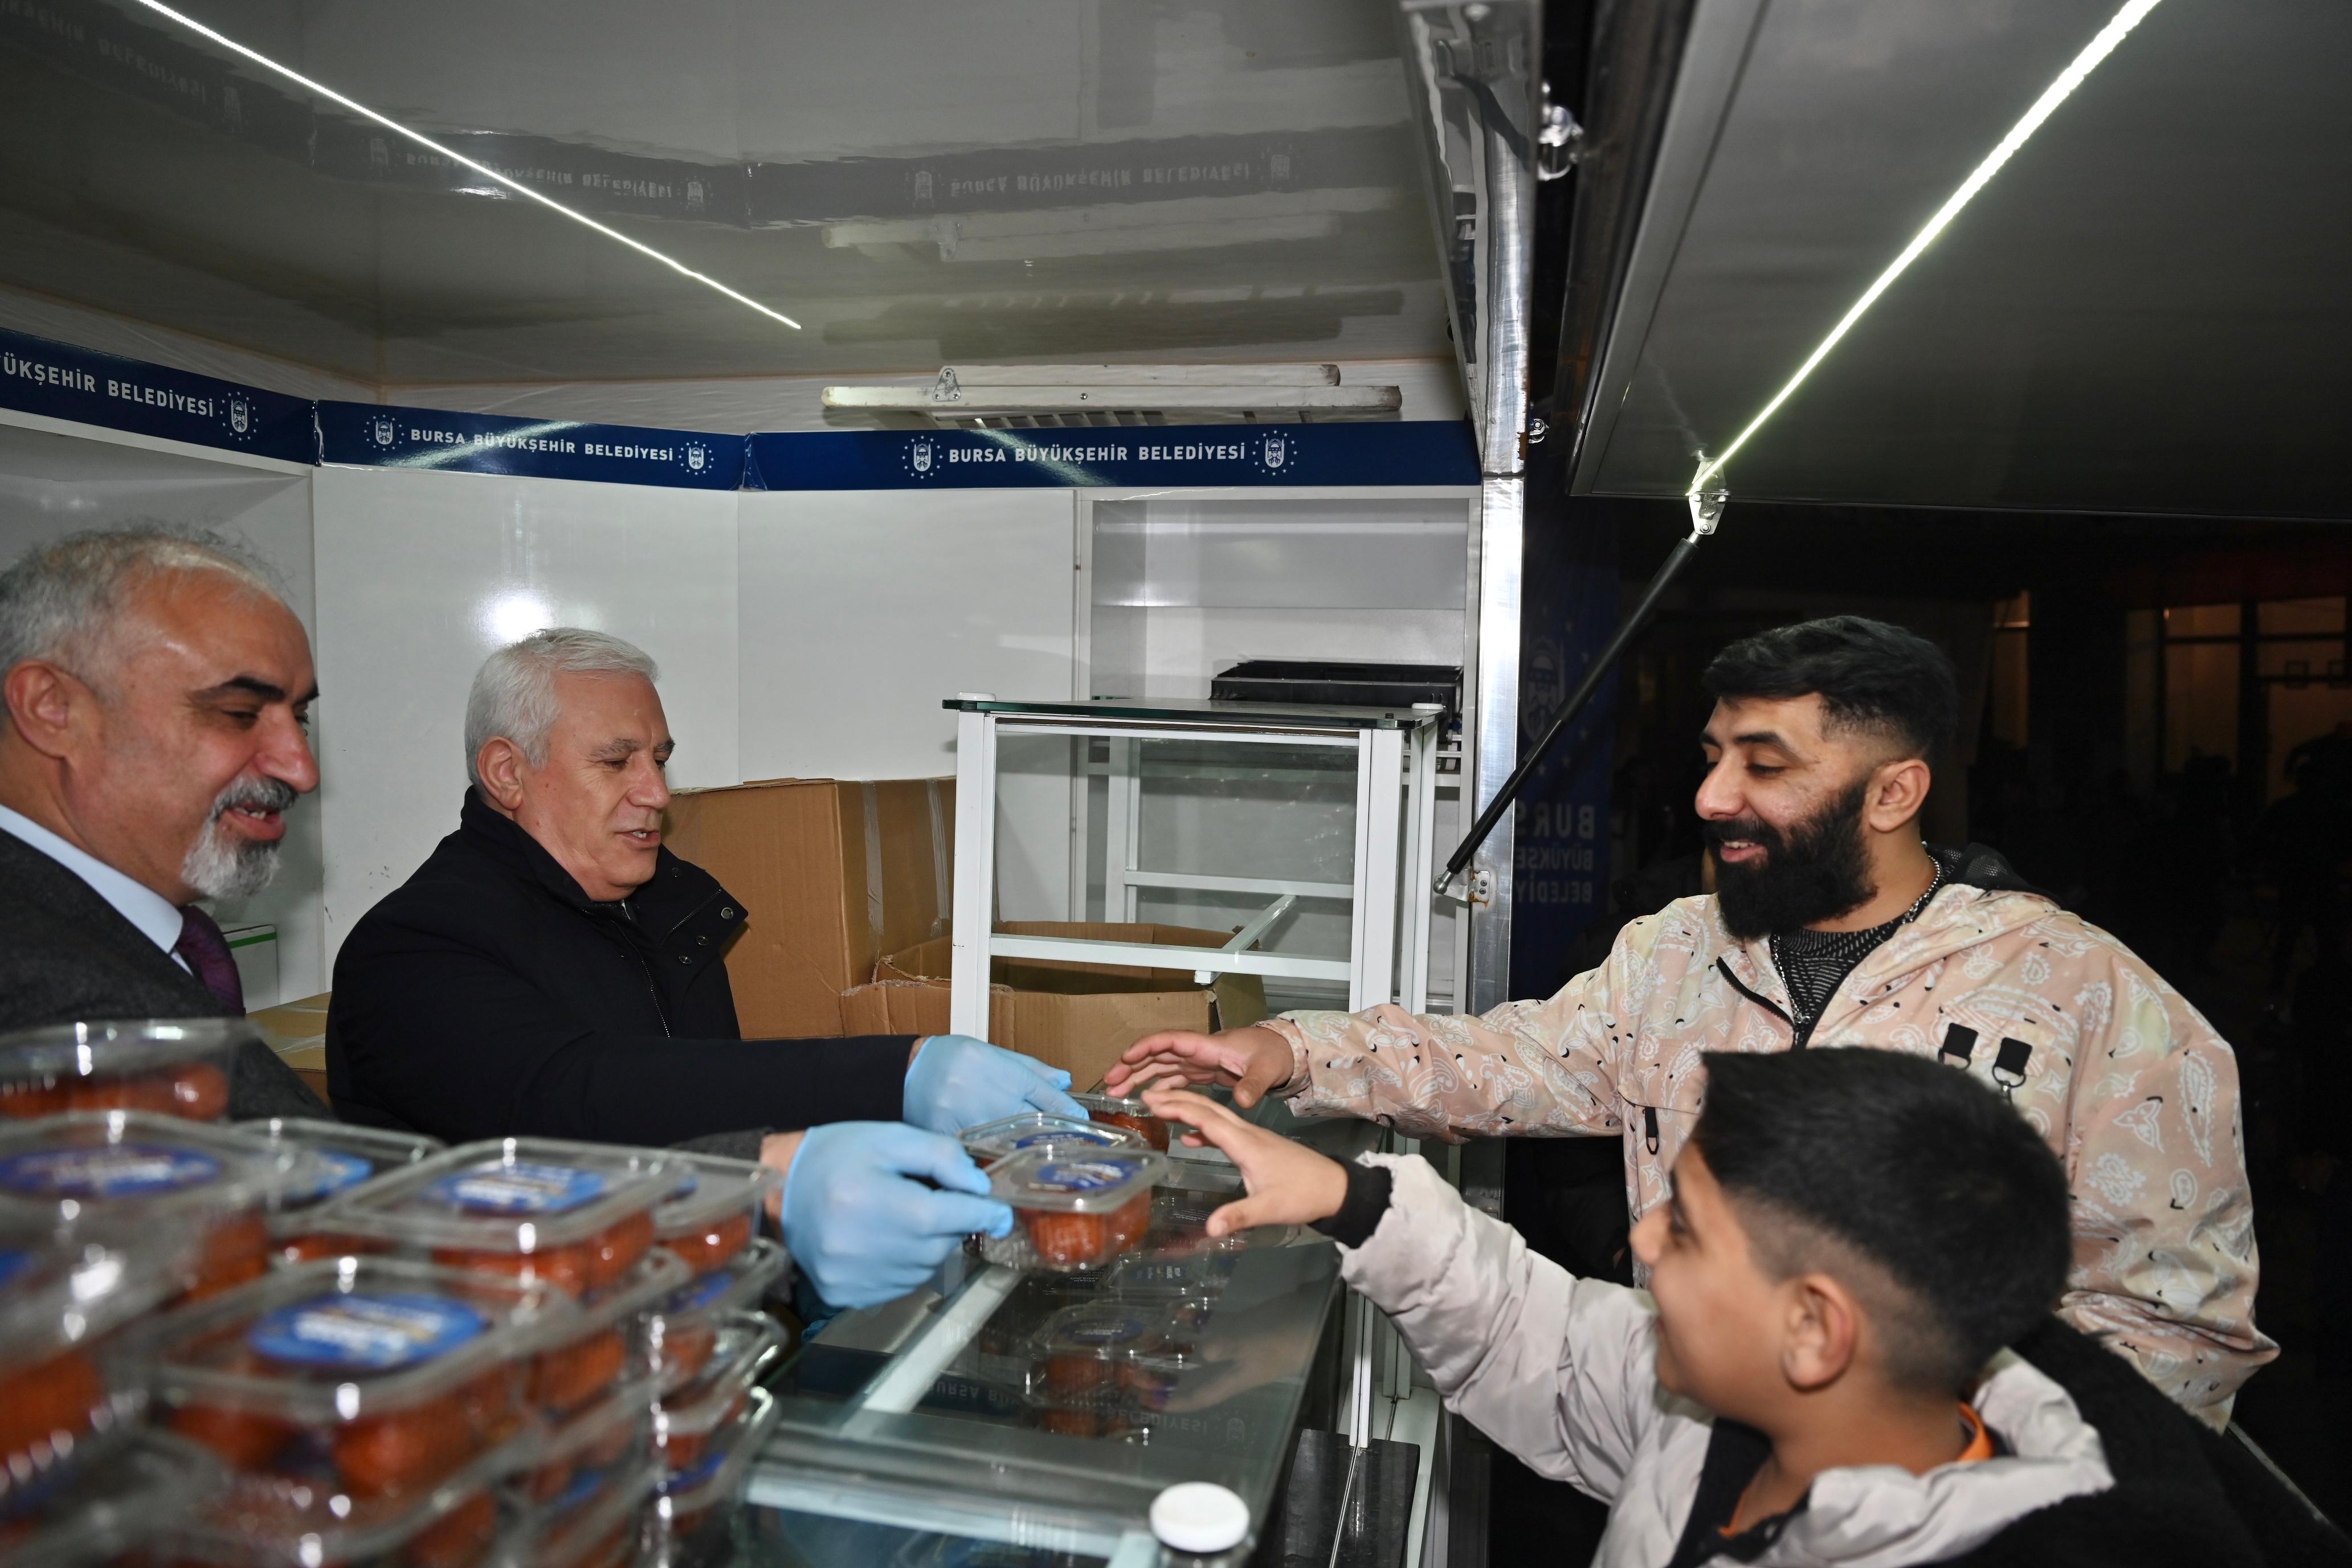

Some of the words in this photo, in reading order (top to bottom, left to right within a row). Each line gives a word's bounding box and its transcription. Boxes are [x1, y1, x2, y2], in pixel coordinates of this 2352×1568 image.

[0, 352, 96, 392] ÜKŞEHİR
[108, 379, 213, 416] BELEDİYESİ
[411, 429, 465, 444] BURSA
[474, 432, 575, 453] BÜYÜKŞEHİR
[585, 443, 672, 461] BELEDİYESİ
[949, 448, 1006, 463] BURSA
[1015, 444, 1128, 464] BÜYÜKŞEHİR
[1140, 442, 1245, 460] BELEDİYESİ
